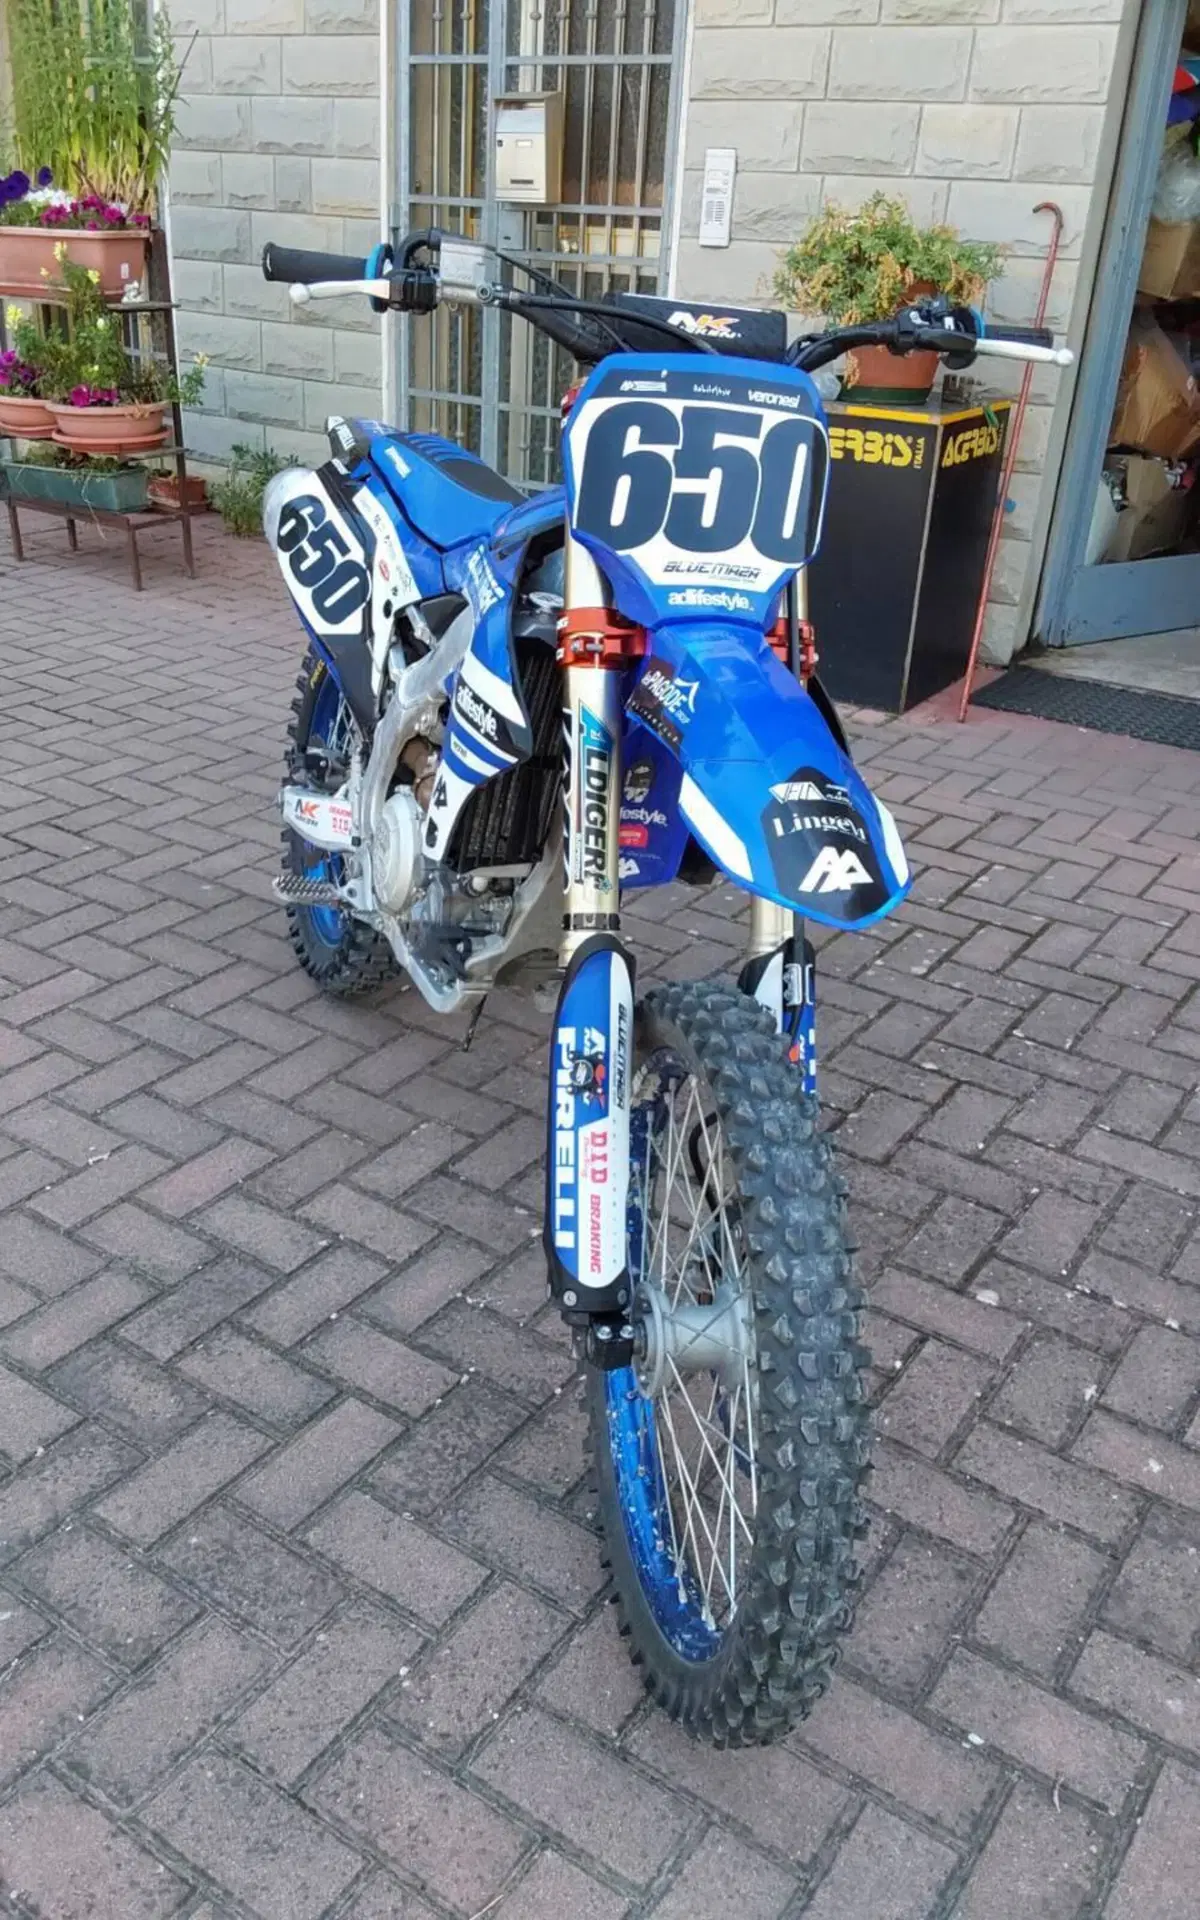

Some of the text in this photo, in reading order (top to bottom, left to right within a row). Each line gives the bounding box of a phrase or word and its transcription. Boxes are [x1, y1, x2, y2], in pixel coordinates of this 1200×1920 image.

[577, 401, 827, 563] 650
[277, 495, 371, 625] 650
[555, 1027, 577, 1249] PIRELLI
[589, 1194, 602, 1274] BRAKING
